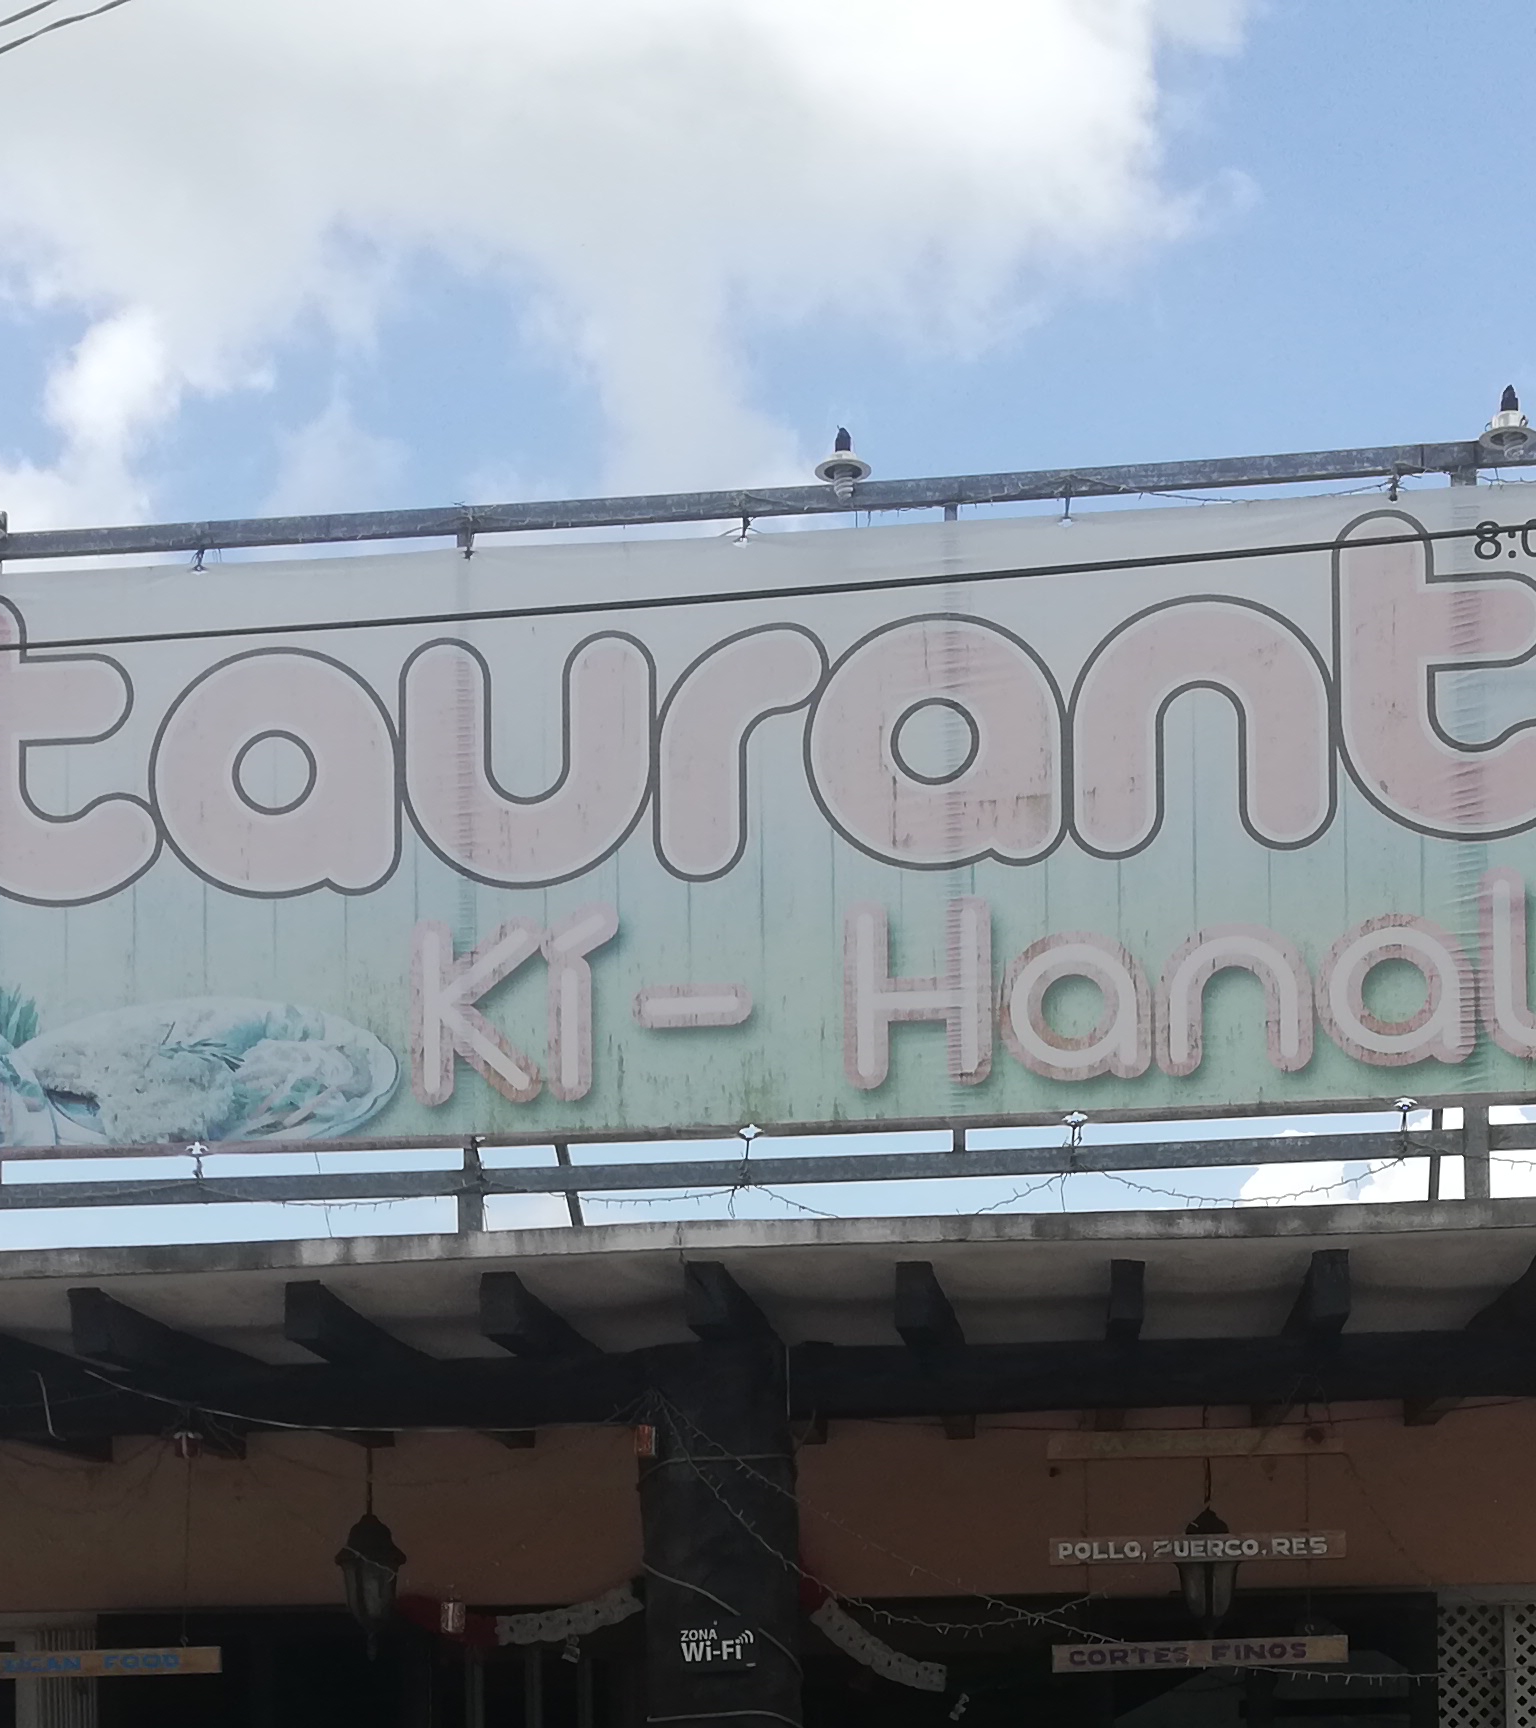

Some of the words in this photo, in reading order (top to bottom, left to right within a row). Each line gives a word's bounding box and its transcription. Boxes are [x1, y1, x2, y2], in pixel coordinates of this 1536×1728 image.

[1058, 1540, 1147, 1561] POLLO,
[1271, 1536, 1328, 1555] RES
[680, 1628, 718, 1642] ZONA
[103, 1654, 180, 1669] FOOD
[681, 1639, 742, 1662] Wi-Fi
[1068, 1646, 1190, 1666] CORTES
[1211, 1642, 1307, 1661] FINOS
